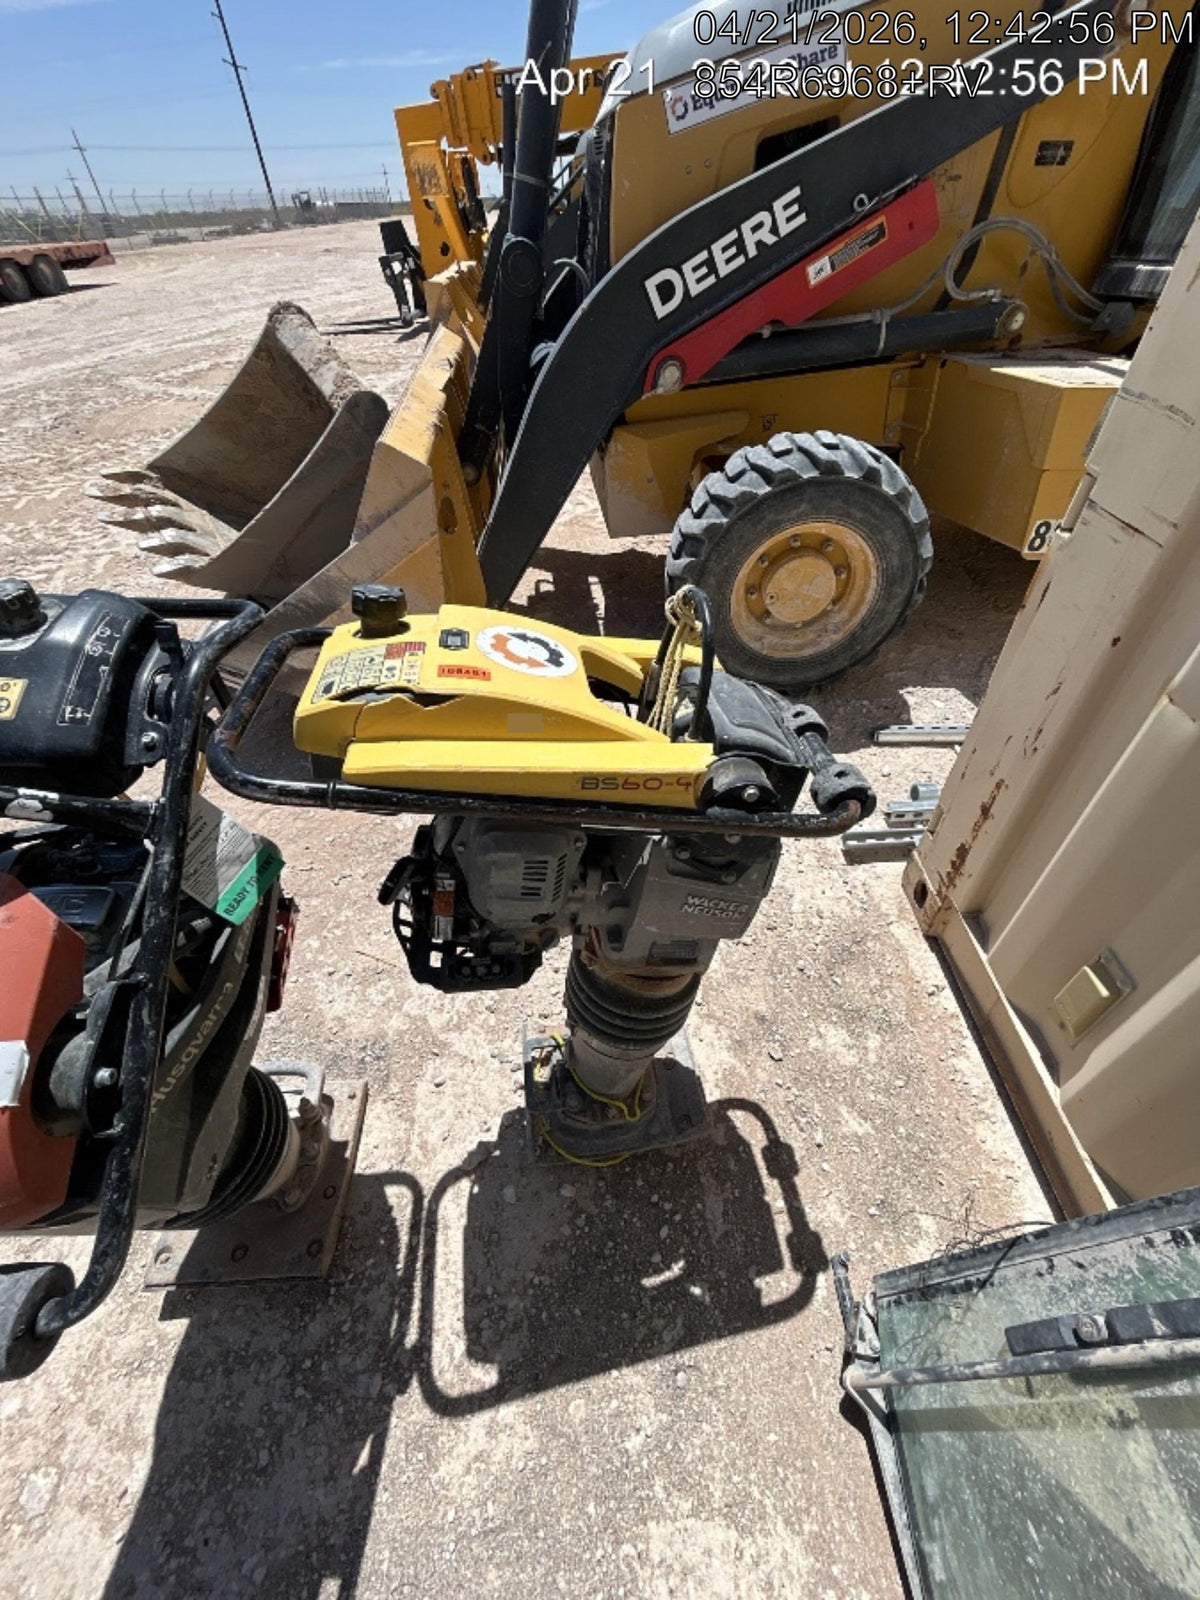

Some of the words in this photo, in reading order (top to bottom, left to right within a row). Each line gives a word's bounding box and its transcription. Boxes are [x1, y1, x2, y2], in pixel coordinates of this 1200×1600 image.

[643, 185, 808, 321] DEERE
[580, 776, 693, 792] BS60-4
[224, 888, 250, 917] READY
